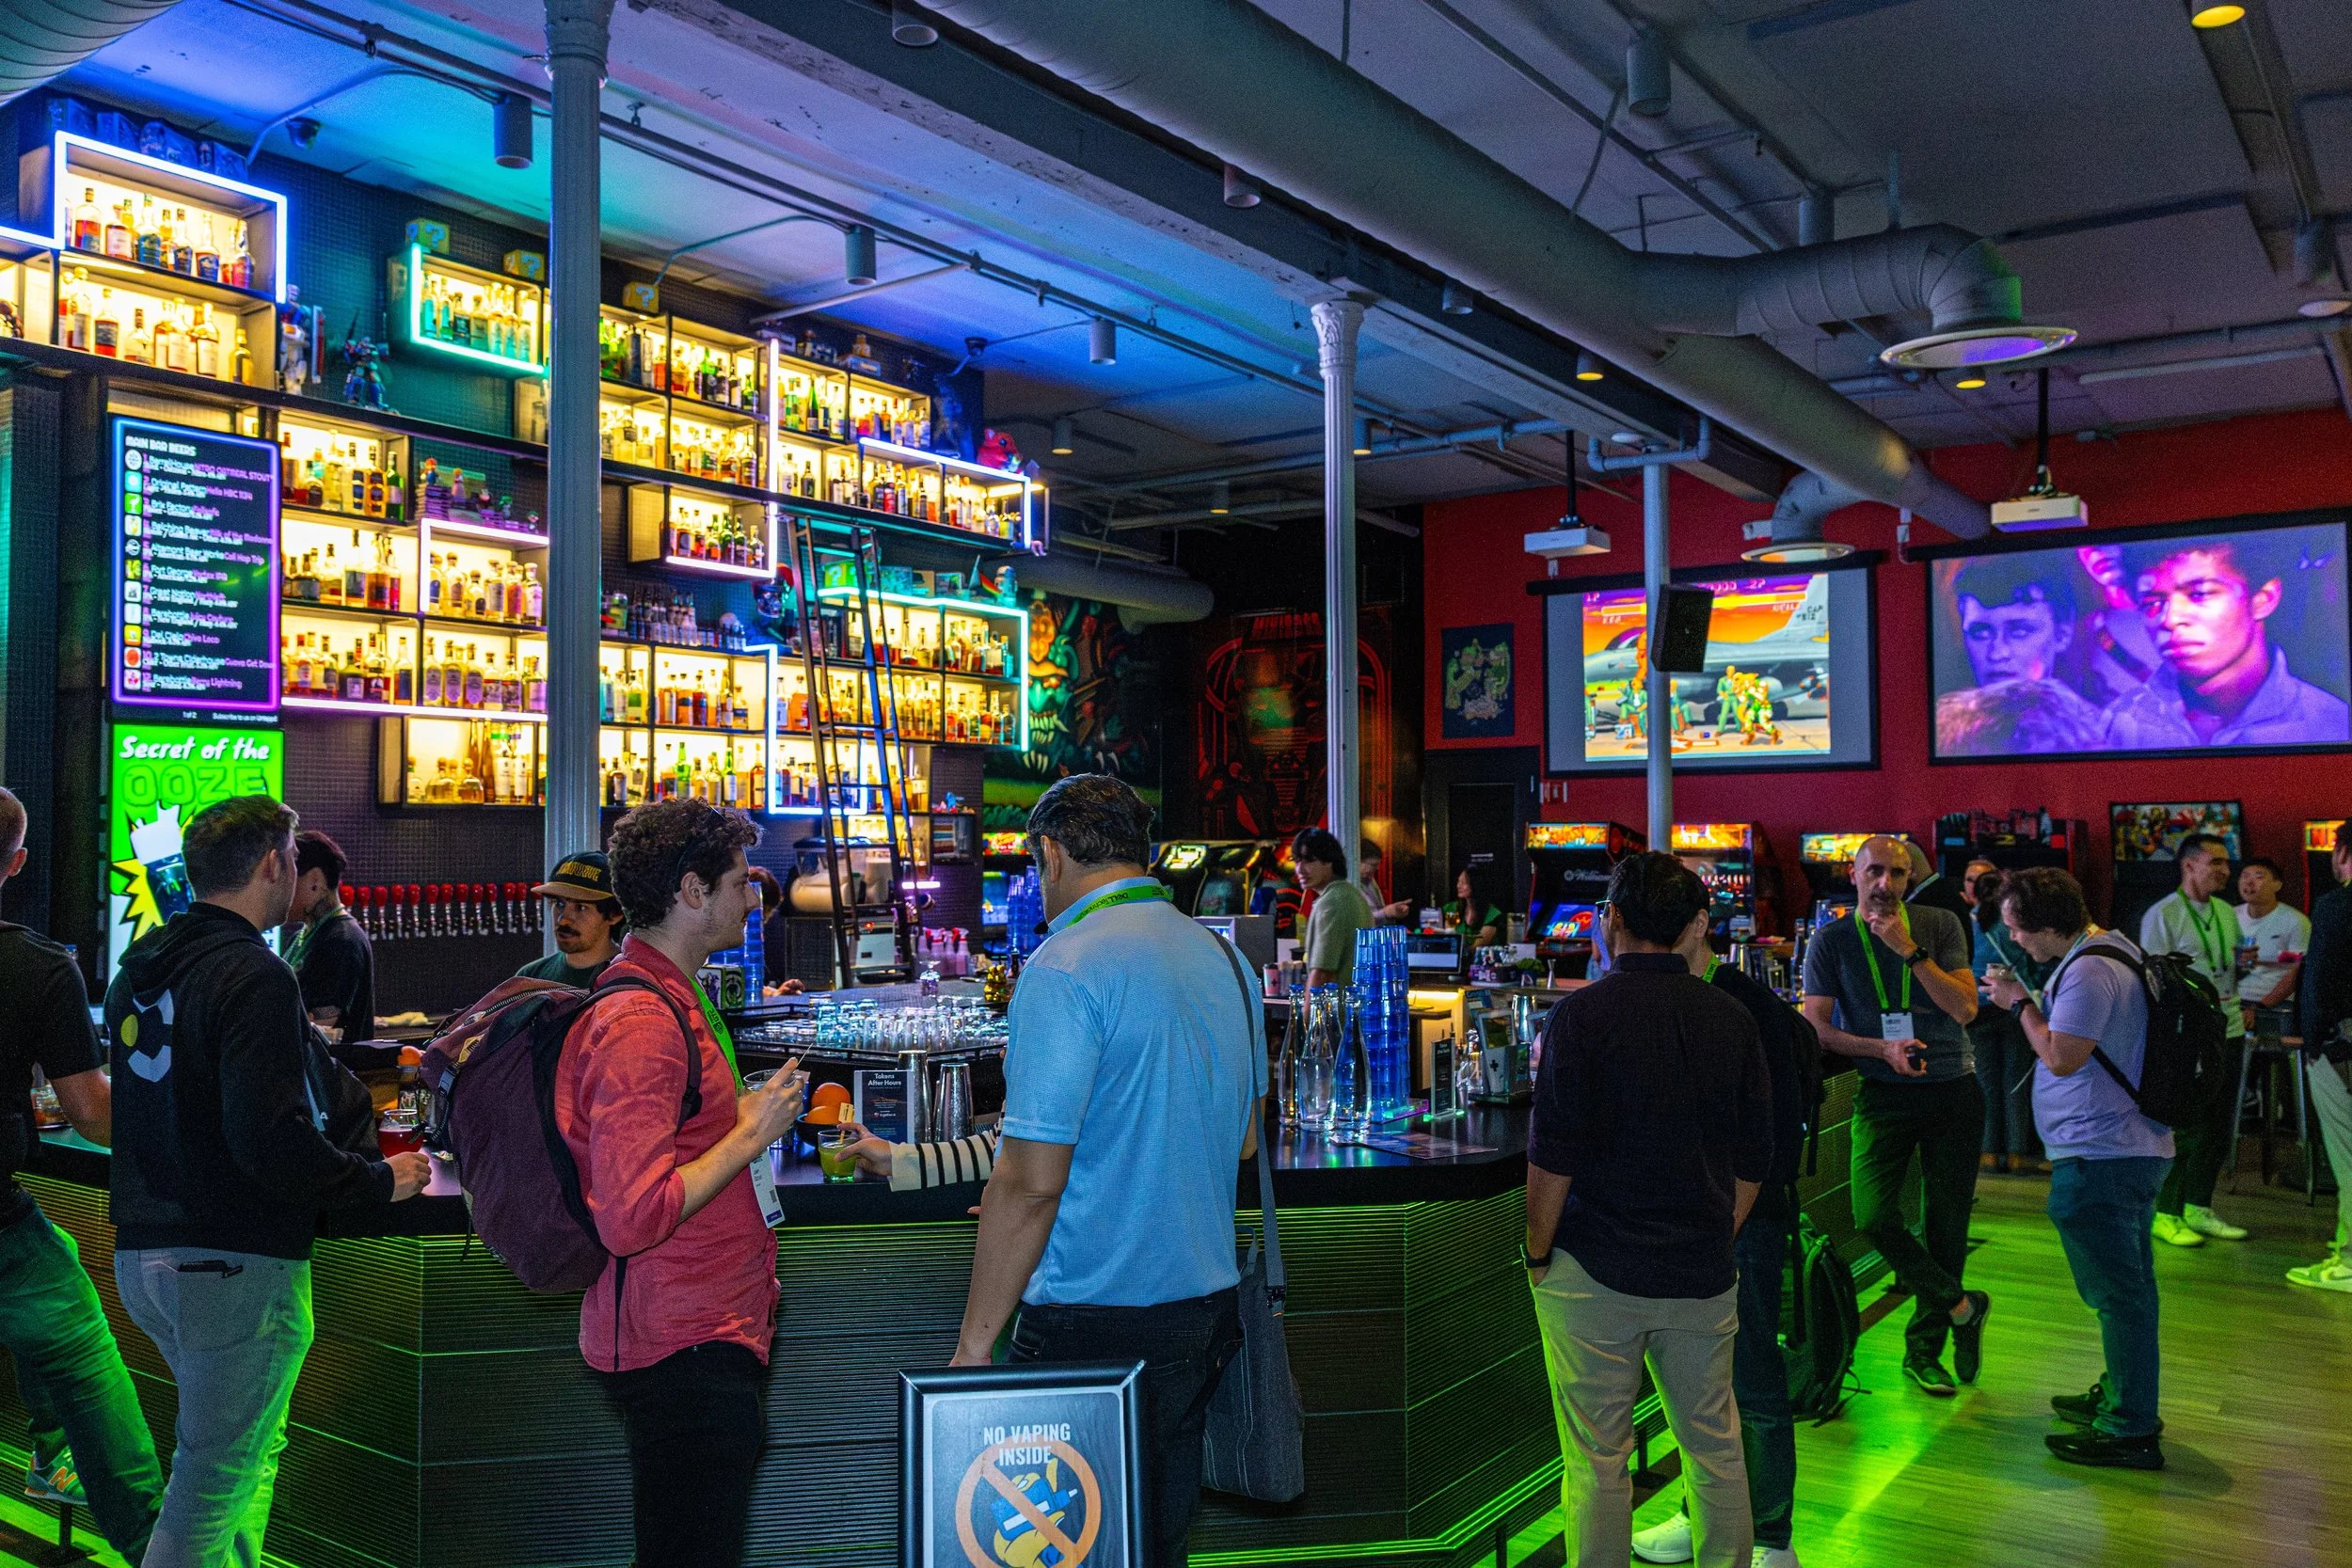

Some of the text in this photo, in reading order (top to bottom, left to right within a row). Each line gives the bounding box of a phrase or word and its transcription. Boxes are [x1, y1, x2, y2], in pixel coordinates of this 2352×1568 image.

[119, 736, 270, 760] Secret of the
[122, 764, 267, 807] OOZE
[983, 1423, 1071, 1446] NO VAPING
[999, 1446, 1052, 1466] INSIDE
